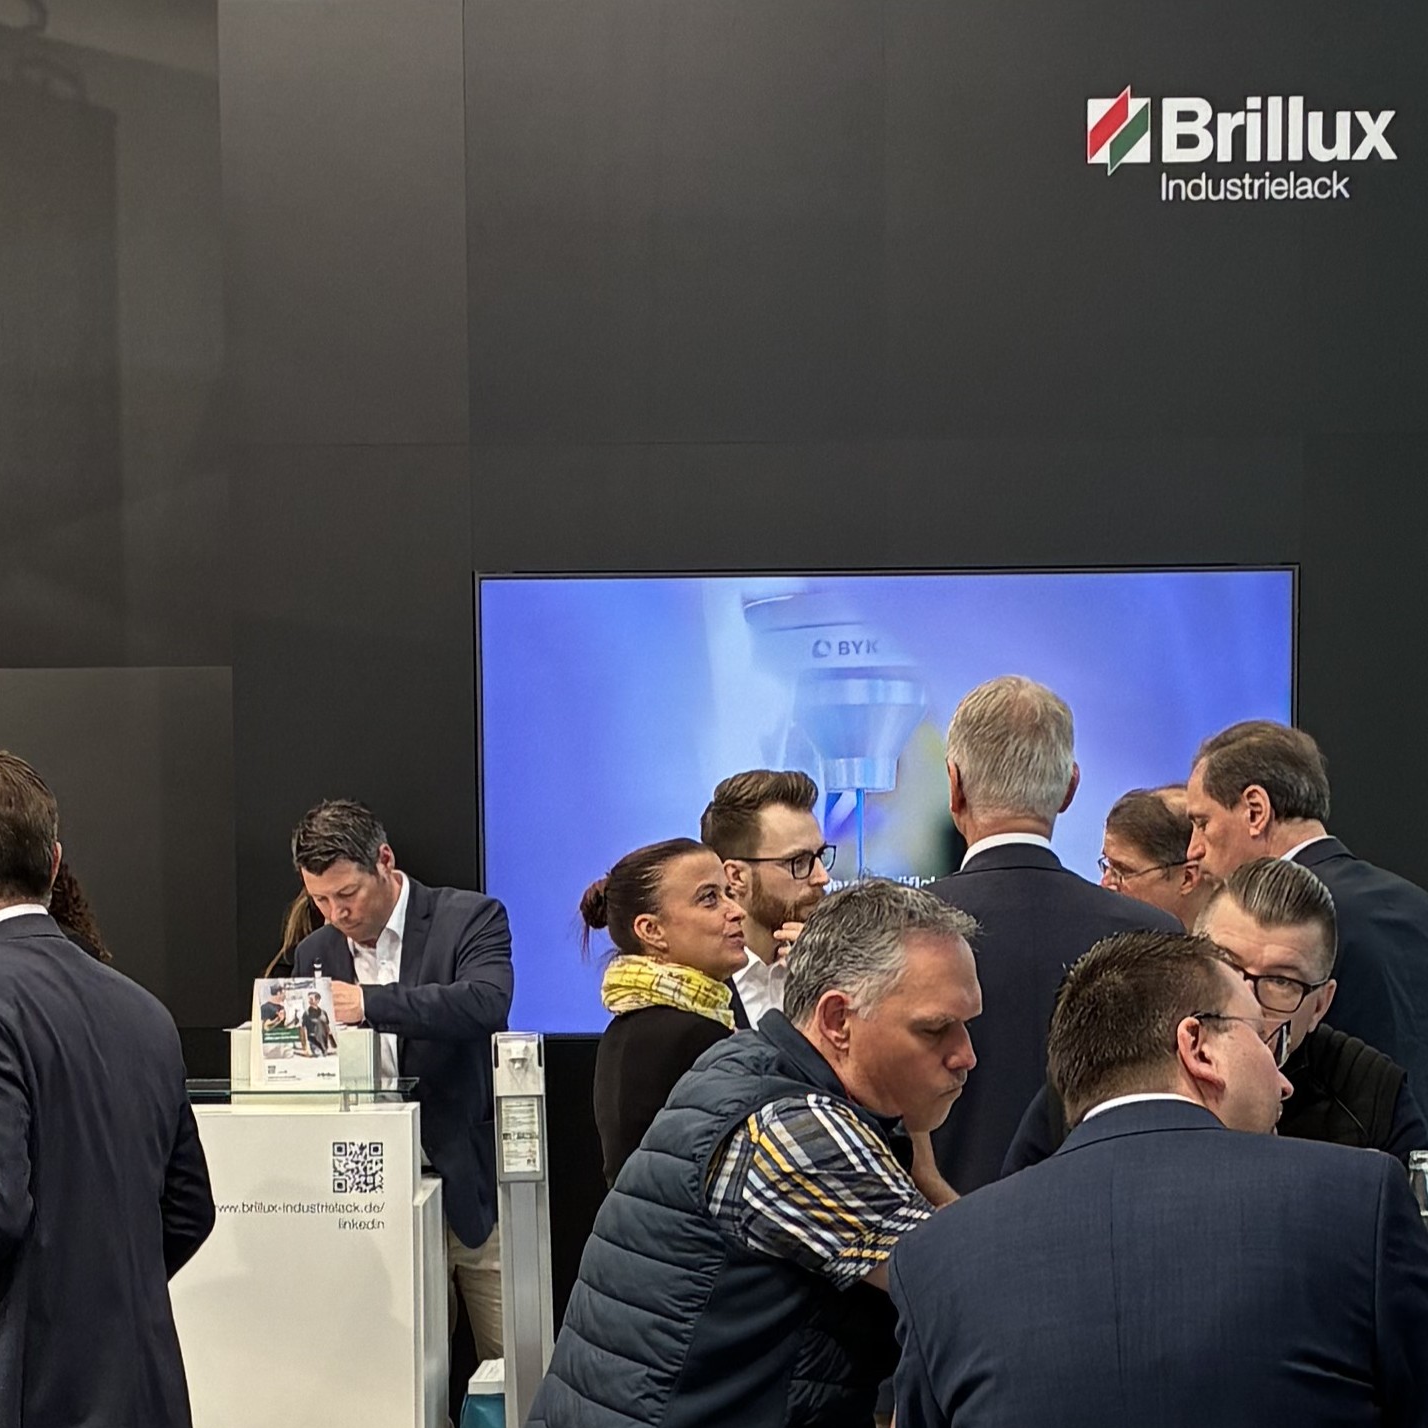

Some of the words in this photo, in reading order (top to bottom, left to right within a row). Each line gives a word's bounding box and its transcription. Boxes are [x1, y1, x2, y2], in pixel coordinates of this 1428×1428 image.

[1161, 95, 1398, 163] Brillux
[1161, 170, 1350, 201] Industrielack
[838, 639, 878, 656] BYK
